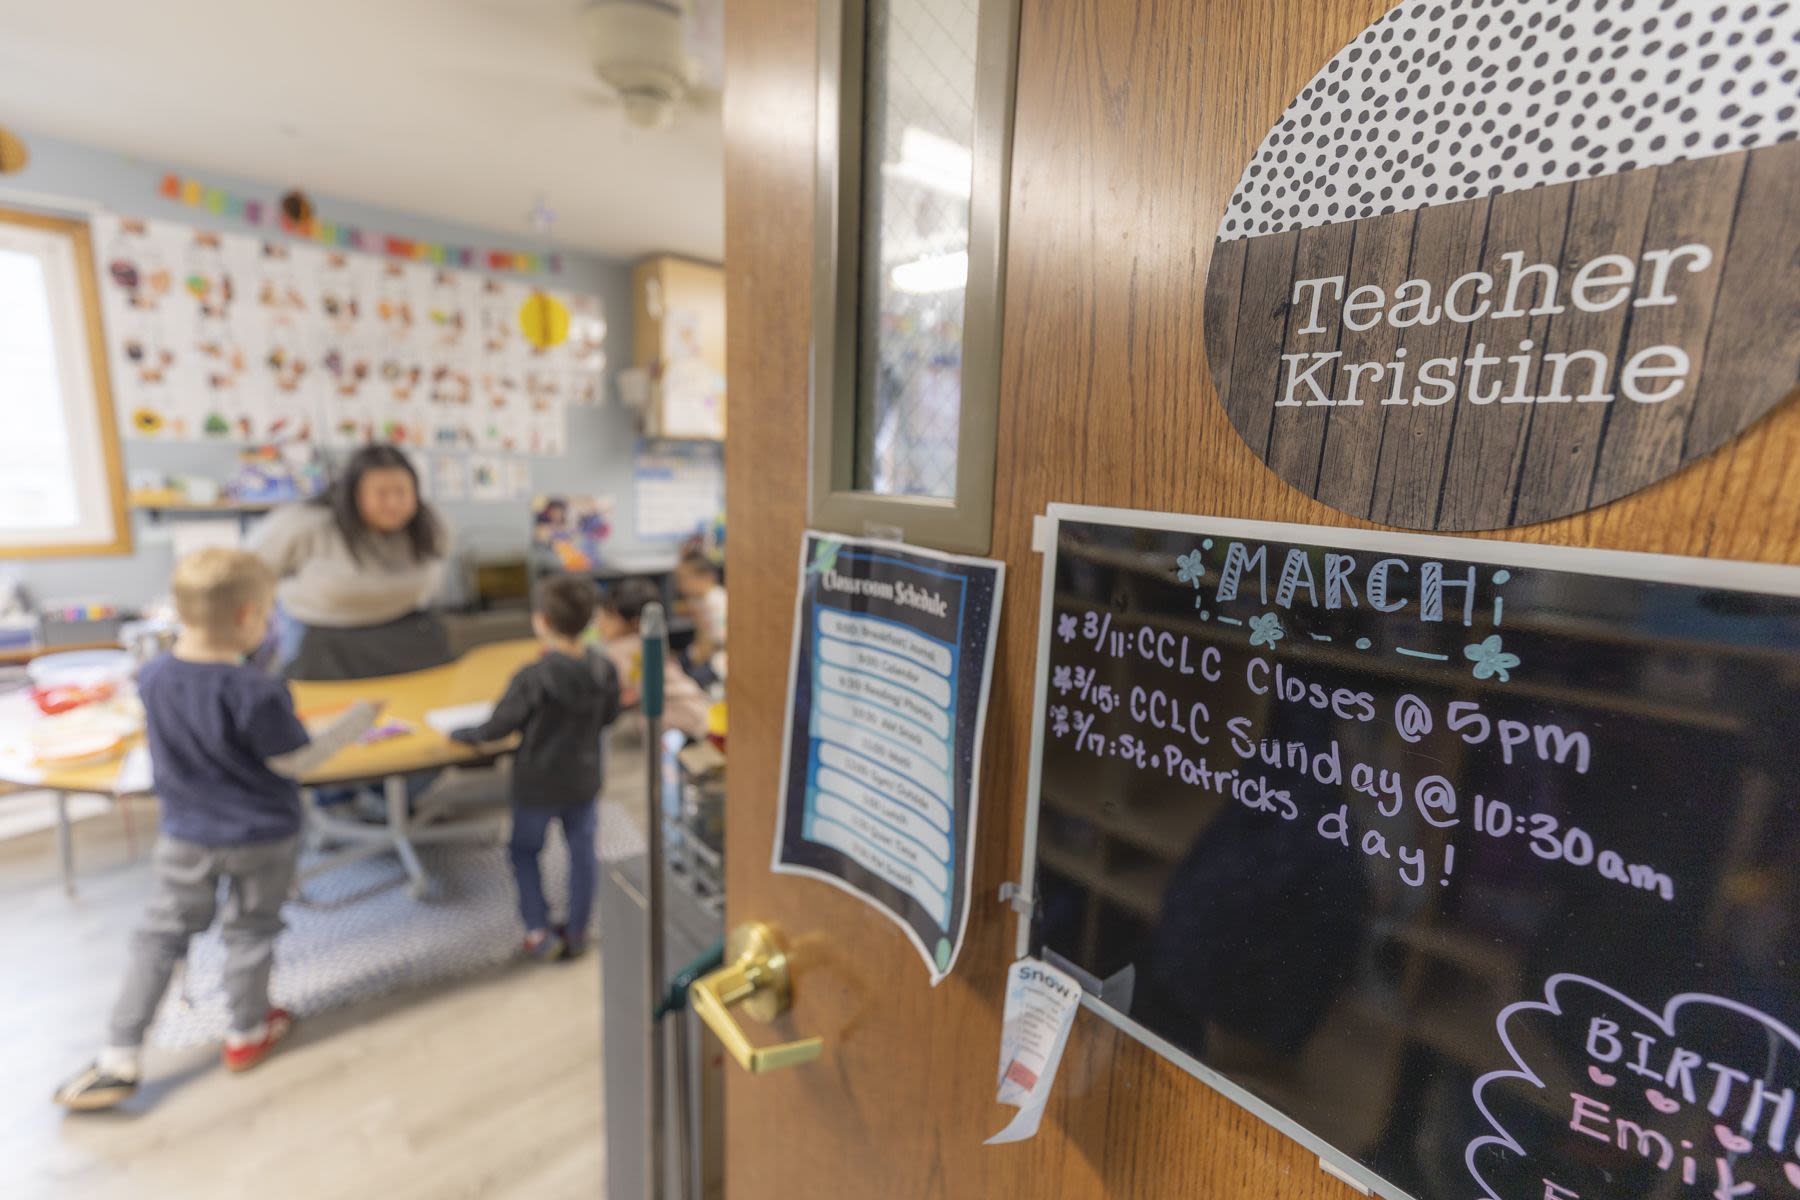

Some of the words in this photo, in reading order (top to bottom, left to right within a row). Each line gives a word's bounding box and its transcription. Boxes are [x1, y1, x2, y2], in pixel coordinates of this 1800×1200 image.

[1292, 243, 1713, 335] Teacher
[1274, 339, 1691, 408] Kristine
[822, 568, 893, 600] Classroom
[894, 580, 948, 618] Schedule
[1247, 657, 1376, 722] Closes
[1394, 694, 1433, 743] @
[1447, 701, 1591, 774] 5pm
[1130, 686, 1210, 745] CCLC
[1226, 717, 1402, 817] Sunday
[1415, 775, 1460, 827] @
[1474, 795, 1674, 901] 10:30am
[1316, 804, 1455, 887] day!
